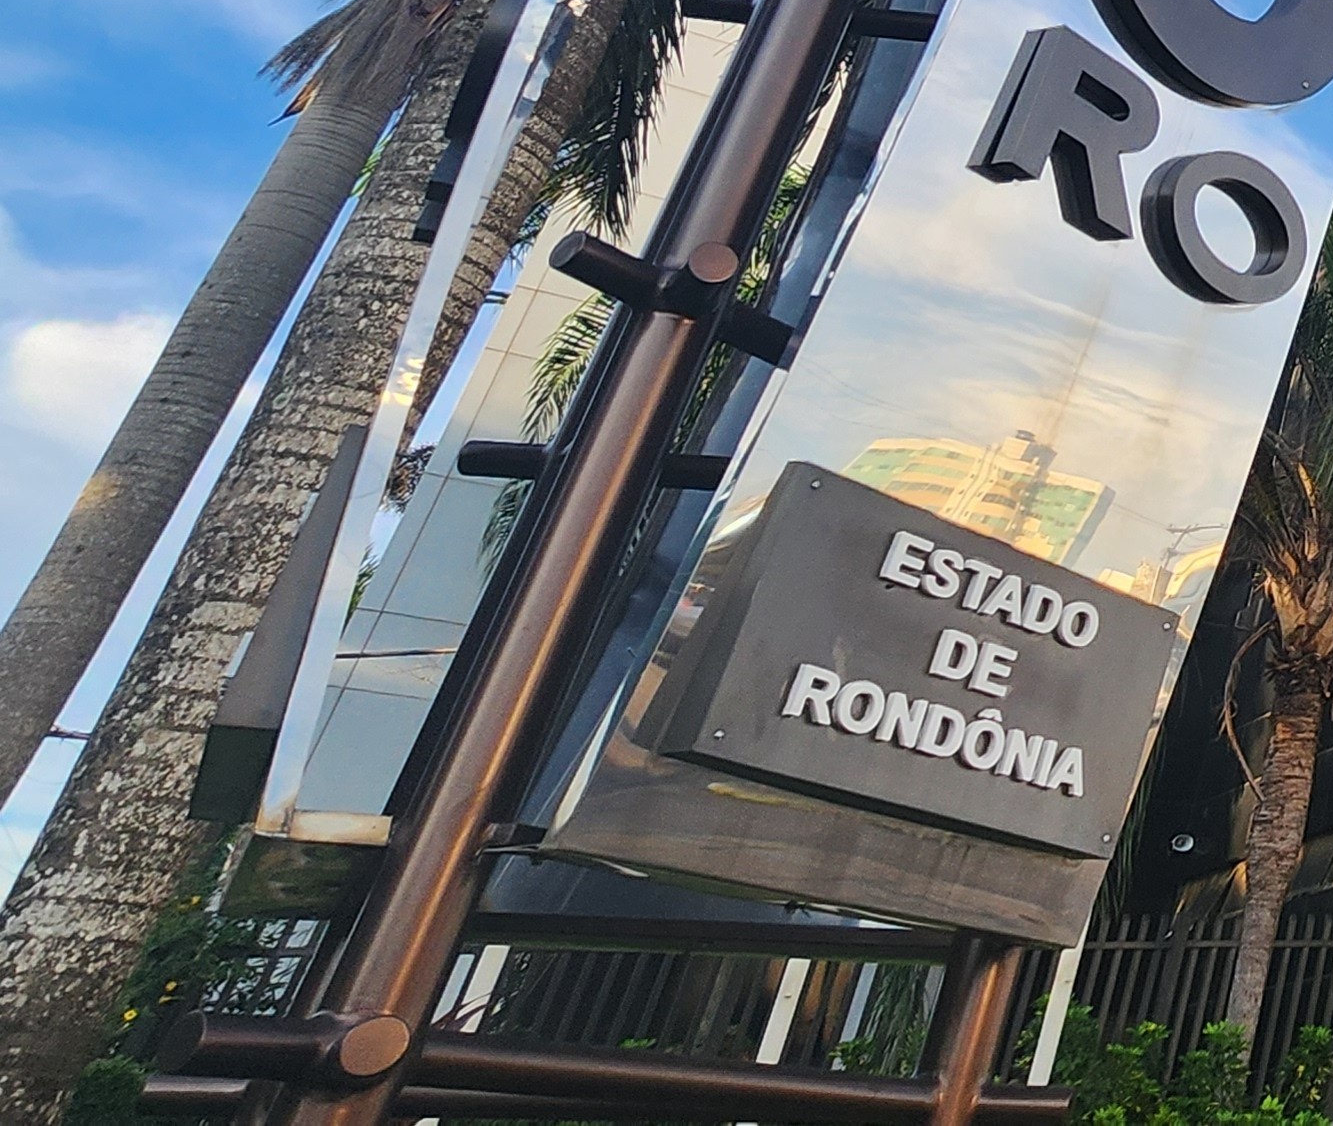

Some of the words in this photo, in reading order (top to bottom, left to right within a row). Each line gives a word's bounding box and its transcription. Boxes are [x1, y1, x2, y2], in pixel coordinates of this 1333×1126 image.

[966, 25, 1308, 305] RO
[879, 531, 1100, 648] ESTADO
[928, 628, 1018, 698] DE
[781, 663, 1085, 797] RONDÔNIA
